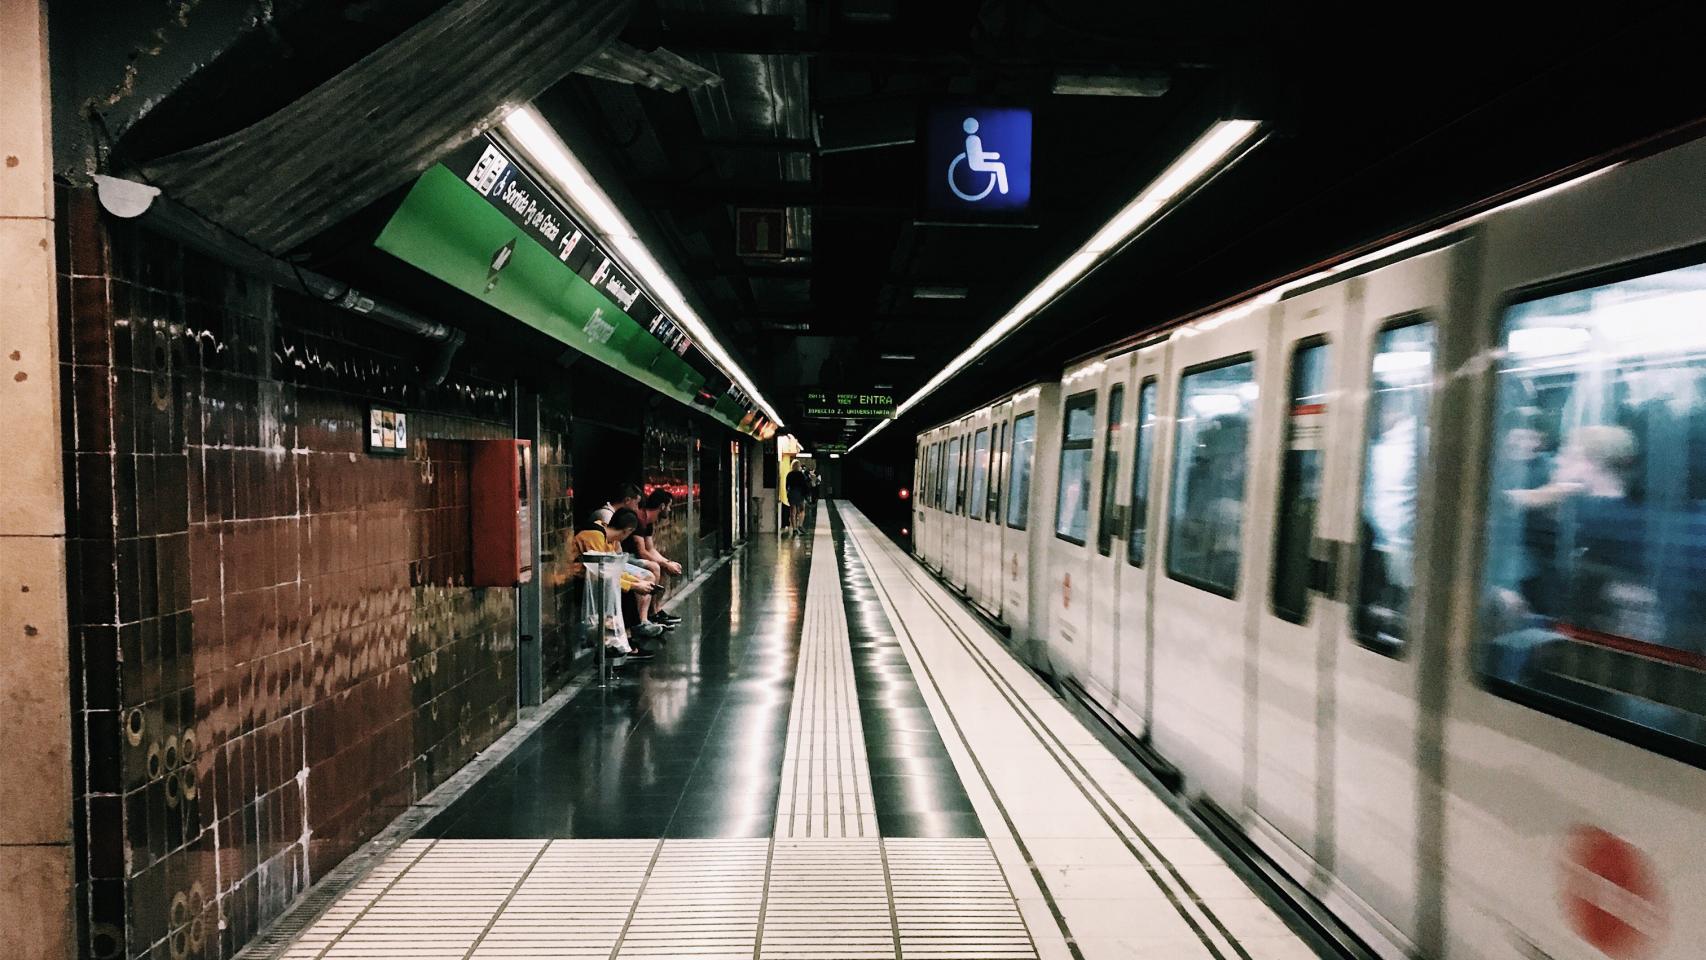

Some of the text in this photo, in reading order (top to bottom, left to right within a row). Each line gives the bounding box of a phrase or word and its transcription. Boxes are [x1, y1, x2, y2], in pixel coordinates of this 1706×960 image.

[502, 180, 560, 242] Sortida Pg de Gràcia
[859, 395, 893, 405] ENTRA
